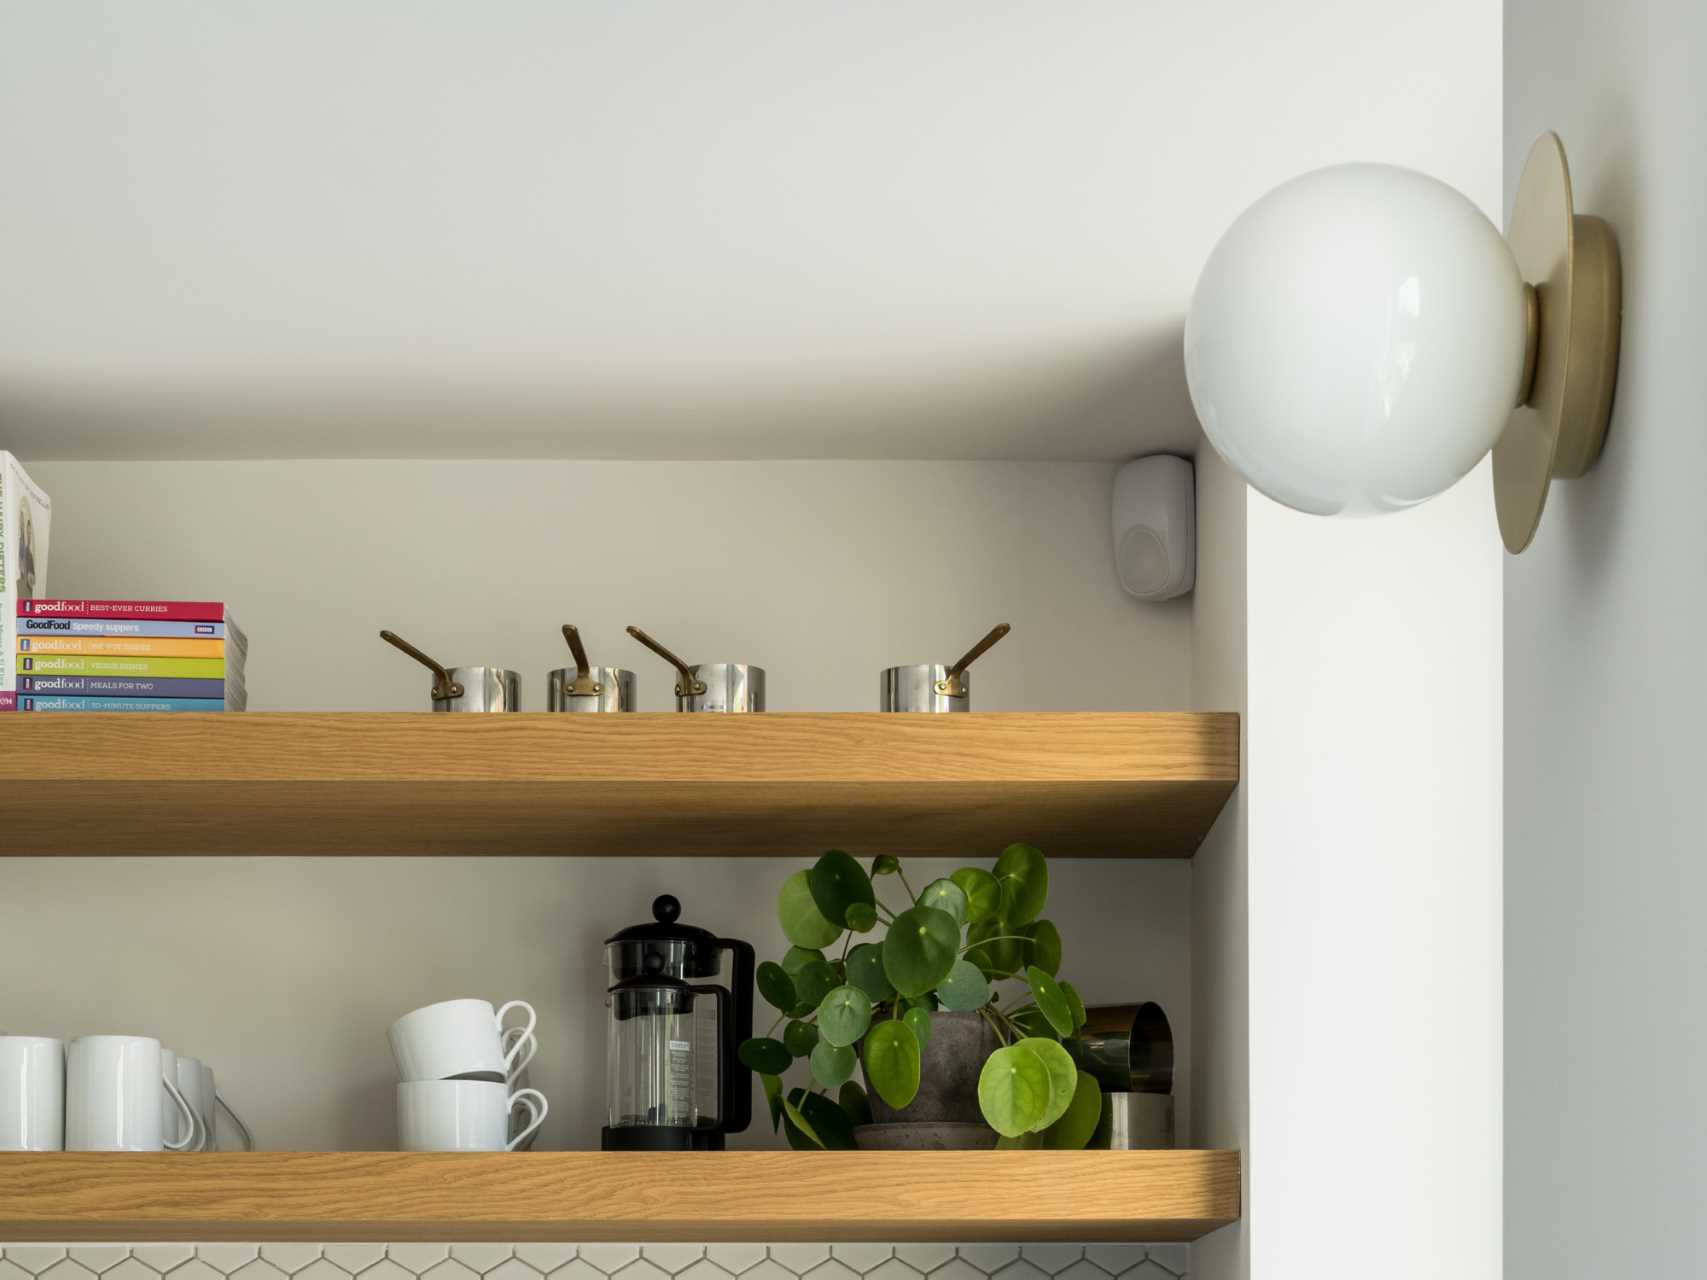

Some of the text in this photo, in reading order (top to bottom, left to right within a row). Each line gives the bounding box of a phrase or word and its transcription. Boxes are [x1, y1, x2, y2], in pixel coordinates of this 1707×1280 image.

[34, 601, 85, 614] goodfood
[26, 619, 140, 633] GoodFood Speedy suppers
[35, 658, 85, 671] goodfood
[34, 678, 85, 691] goodfood
[90, 681, 118, 689] MEALS
[118, 682, 134, 690] FOR
[134, 682, 154, 691] TWO
[35, 698, 86, 711] goodfood
